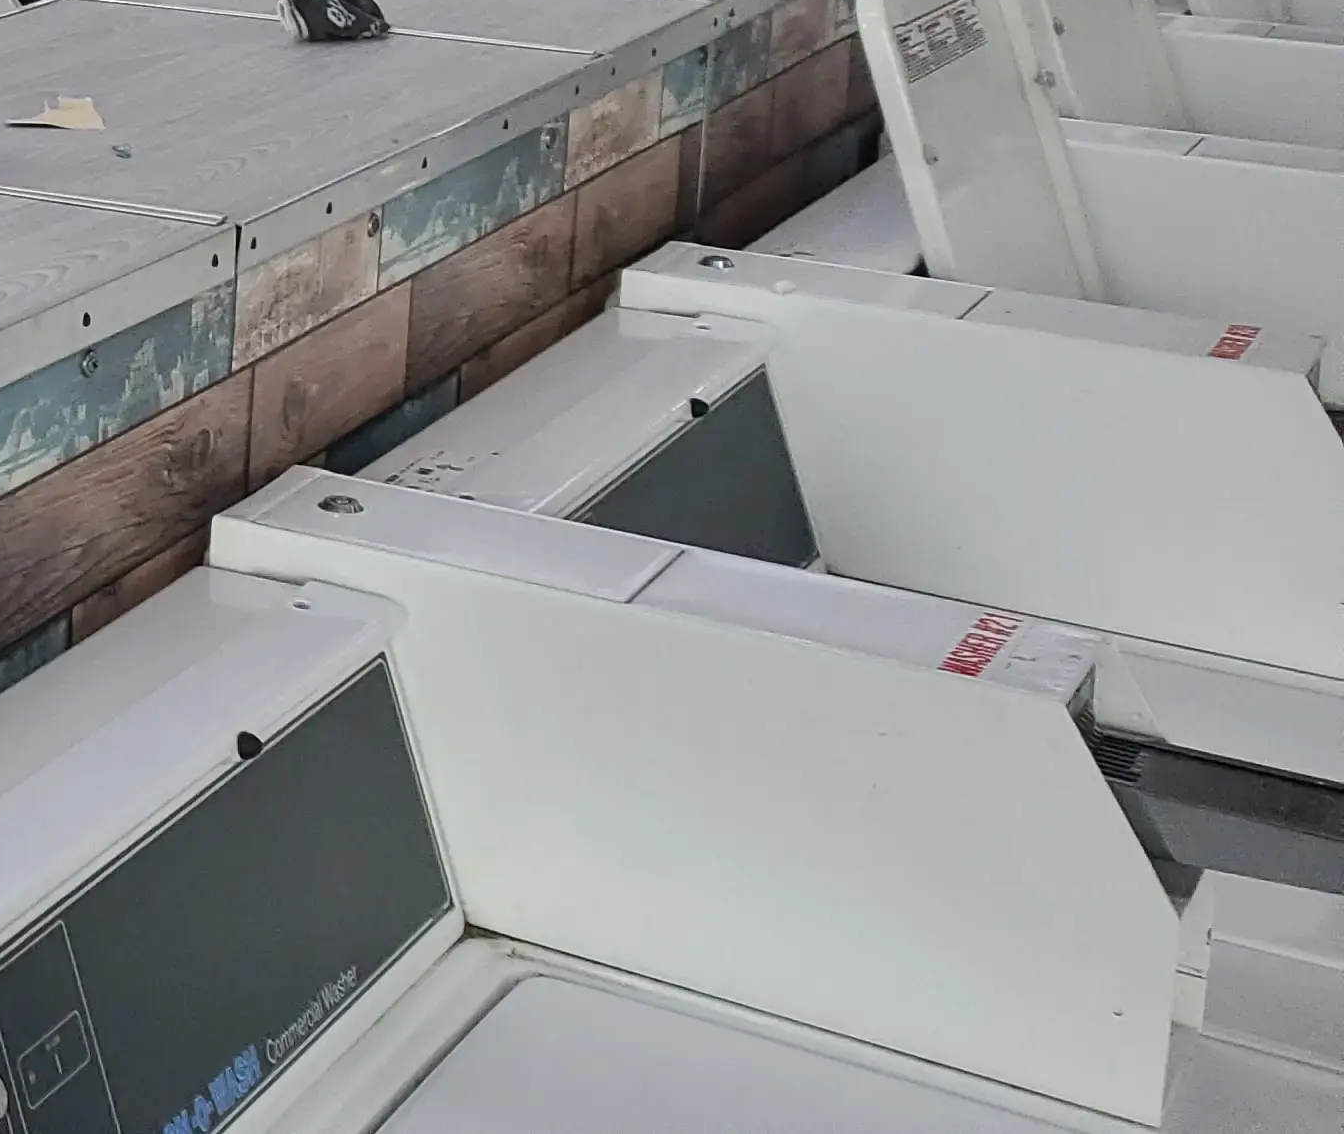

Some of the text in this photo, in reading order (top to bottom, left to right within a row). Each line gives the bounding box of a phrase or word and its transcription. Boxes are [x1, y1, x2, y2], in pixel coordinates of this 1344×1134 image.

[935, 612, 1024, 677] WASHER #21
[265, 997, 326, 1065] Commercial
[320, 965, 359, 1012] Washer
